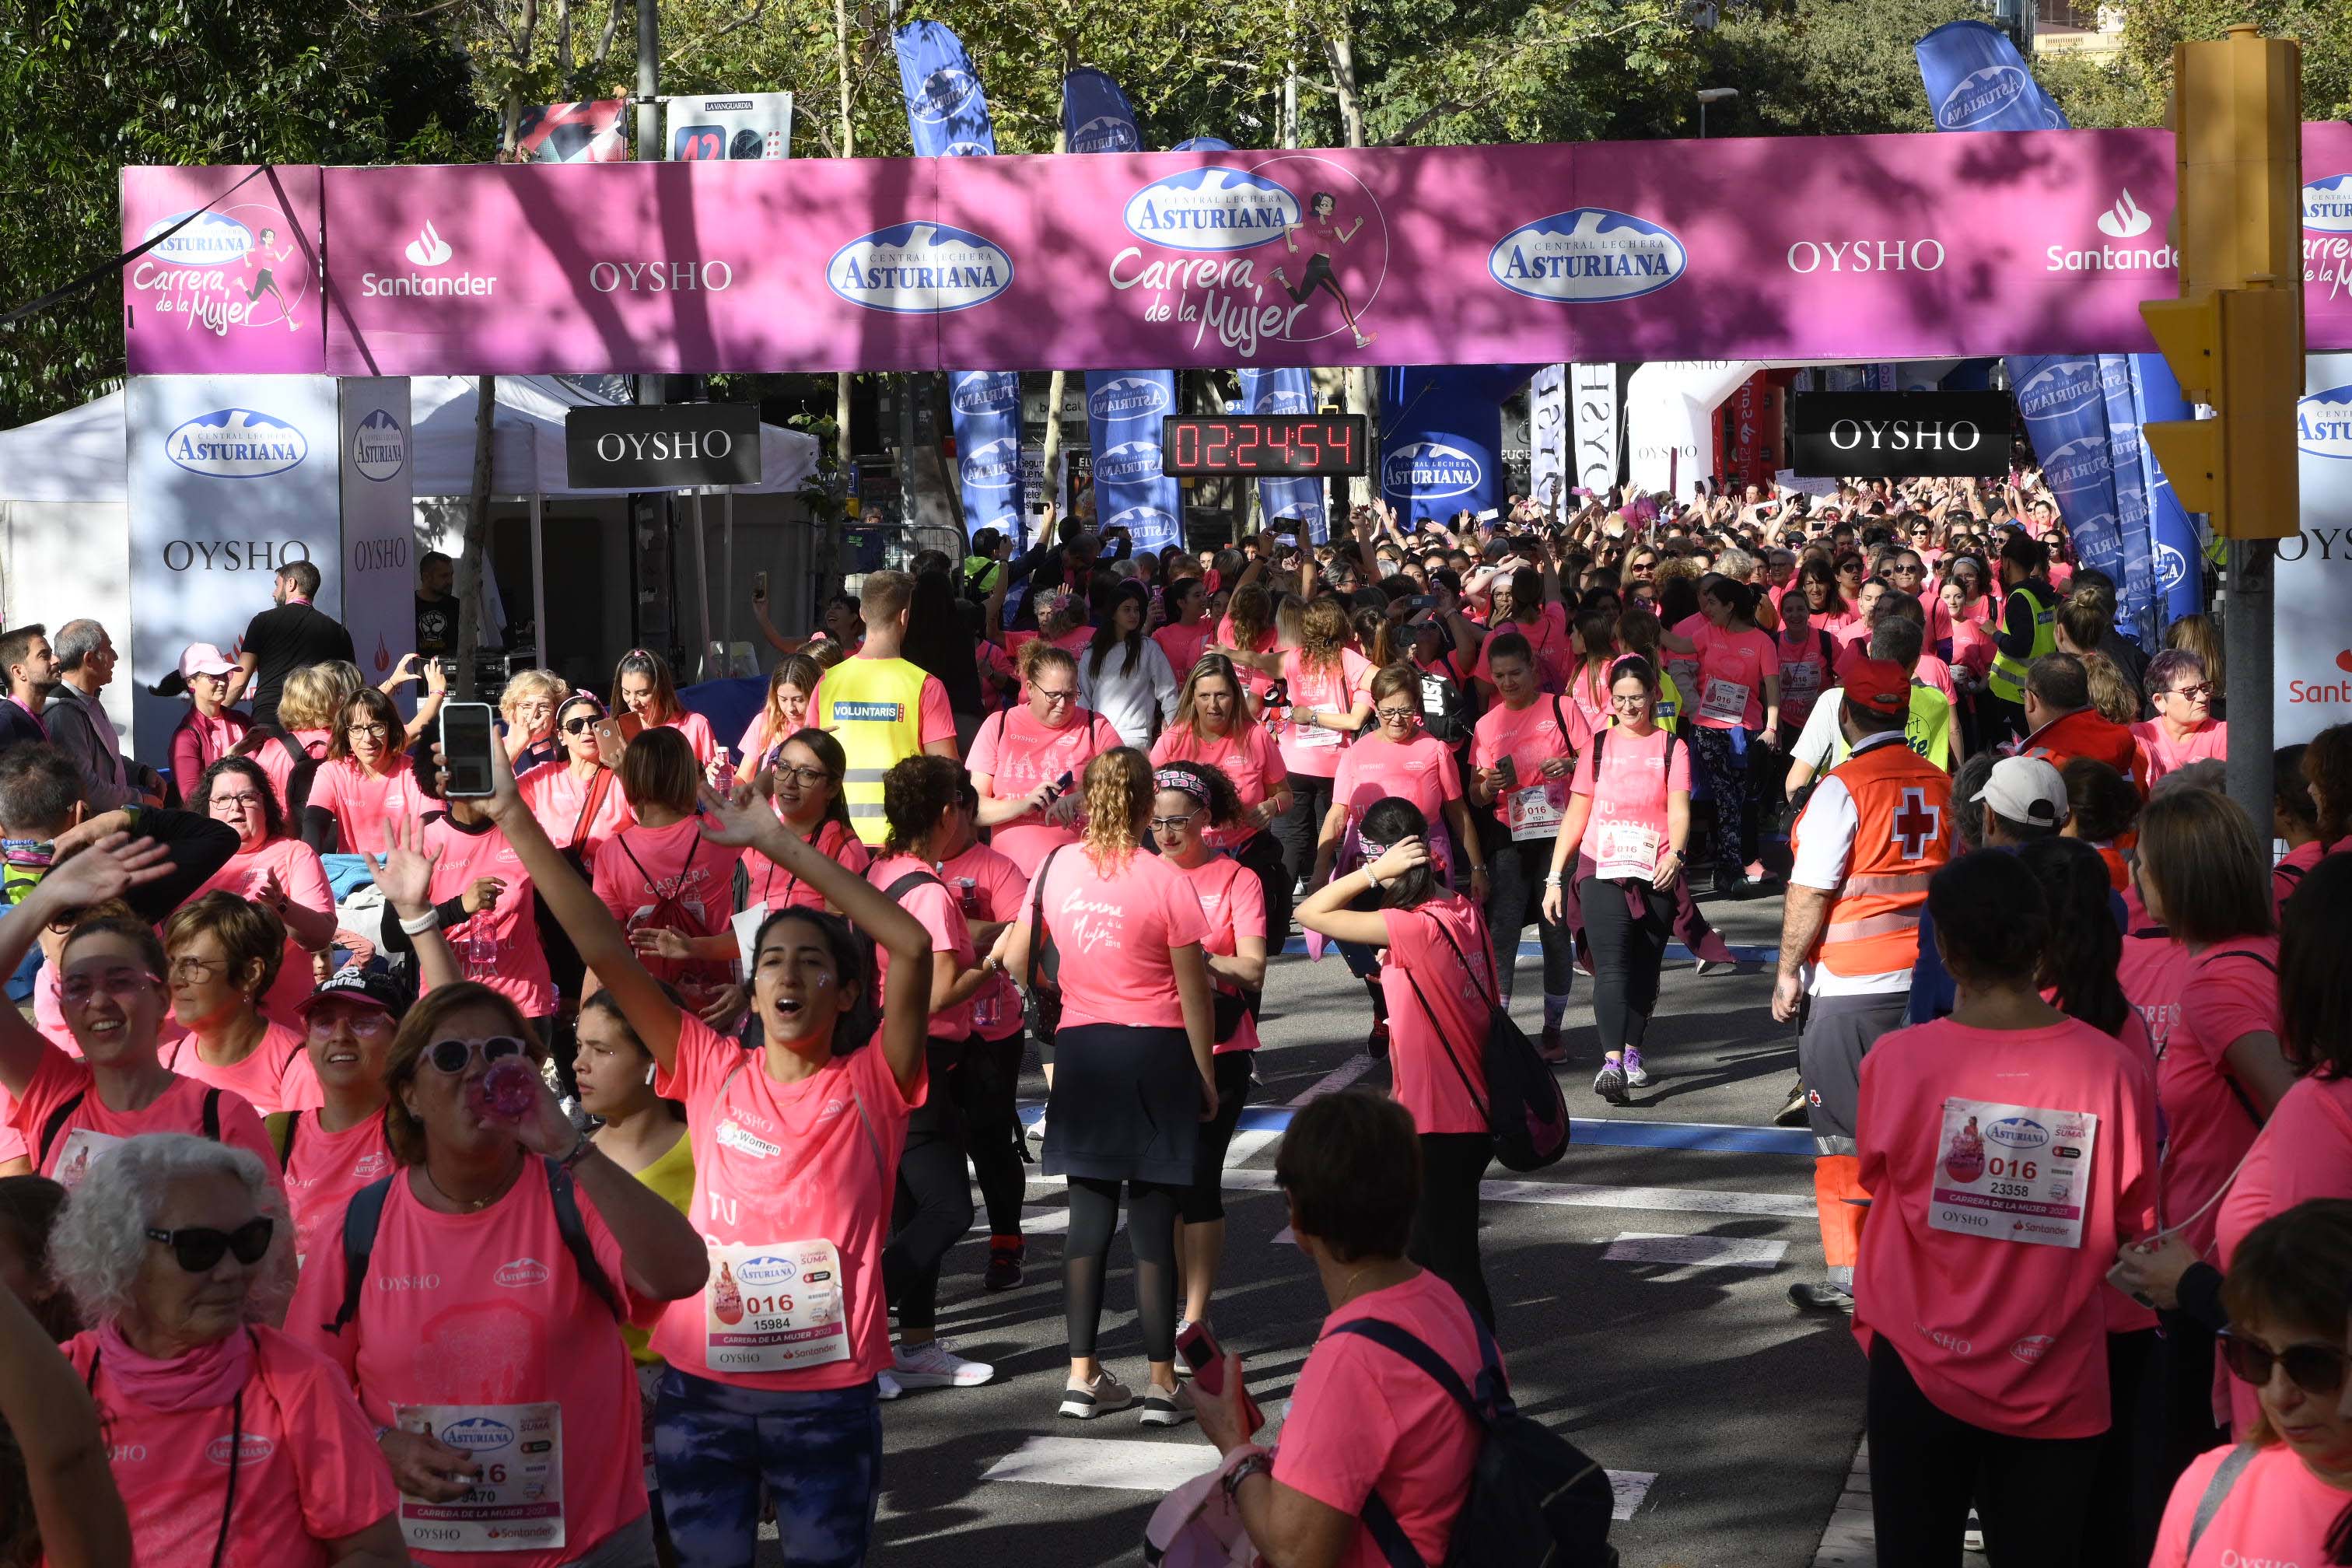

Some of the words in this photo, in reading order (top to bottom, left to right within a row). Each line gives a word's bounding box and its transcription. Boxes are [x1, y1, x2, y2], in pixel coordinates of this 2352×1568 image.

[1164, 195, 1220, 205] CENTRAL
[1226, 194, 1282, 203] LECHERA
[1138, 198, 1286, 229] ASTURIANA
[1535, 241, 1594, 250] CENTRAL
[1601, 240, 1664, 249] LECHERA
[870, 253, 926, 262] CENTRAL
[933, 252, 992, 261] LECHERA
[1504, 245, 1671, 279] ASTURIANA
[1787, 239, 1944, 273] OYSHO
[133, 261, 225, 291] Carrera
[590, 261, 732, 292] OYSHO
[841, 256, 999, 289] ASTURIANA
[1109, 247, 1254, 289] Carrera
[2319, 261, 2333, 282] la
[362, 271, 497, 299] Santander
[156, 292, 173, 312] de
[177, 292, 188, 312] la
[187, 289, 260, 336] Mujer
[1145, 292, 1171, 322] de
[1178, 291, 1196, 322] la
[1192, 285, 1308, 358] Mujer
[1829, 418, 1980, 451] OYSHO
[177, 435, 298, 460] ASTURIANA
[357, 442, 402, 464] ASTURIANA
[597, 429, 732, 462] OYSHO
[1177, 425, 1349, 467] 02:24:54
[1386, 465, 1473, 486] ASTURIANA
[163, 540, 310, 571] OYSHO
[354, 537, 406, 572] OYSHO
[835, 706, 896, 716] VOLUNTARIS
[1010, 733, 1038, 743] OYSHO
[1528, 806, 1546, 814] 016
[1599, 800, 1615, 814] TU
[1617, 845, 1636, 853] 016
[438, 859, 471, 872] OYSHO
[1991, 1126, 2044, 1143] ASTURIANA
[2055, 1129, 2082, 1138] SUMA
[740, 1131, 779, 1154] Women
[1989, 1157, 2037, 1179] 016
[1991, 1182, 2028, 1196] 23358
[709, 1191, 737, 1226] TU
[1949, 1195, 1990, 1206] CARRERA
[2018, 1204, 2047, 1213] MUJER
[1943, 1211, 1988, 1227] OYSHO
[2025, 1223, 2069, 1235] Santander
[741, 1268, 793, 1279] ASTURIANA
[380, 1274, 440, 1291] OYSHO
[747, 1294, 794, 1314] 016
[754, 1318, 790, 1331] 15984
[784, 1332, 811, 1341] MUJER
[814, 1328, 831, 1337] 2023
[720, 1353, 760, 1363] OYSHO
[795, 1344, 837, 1358] Santander
[447, 1430, 508, 1444] ASTURIANA
[212, 1447, 268, 1458] ASTRIANA
[526, 1507, 547, 1516] 2023
[414, 1528, 460, 1541] OYSHO
[501, 1528, 551, 1538] Santander
